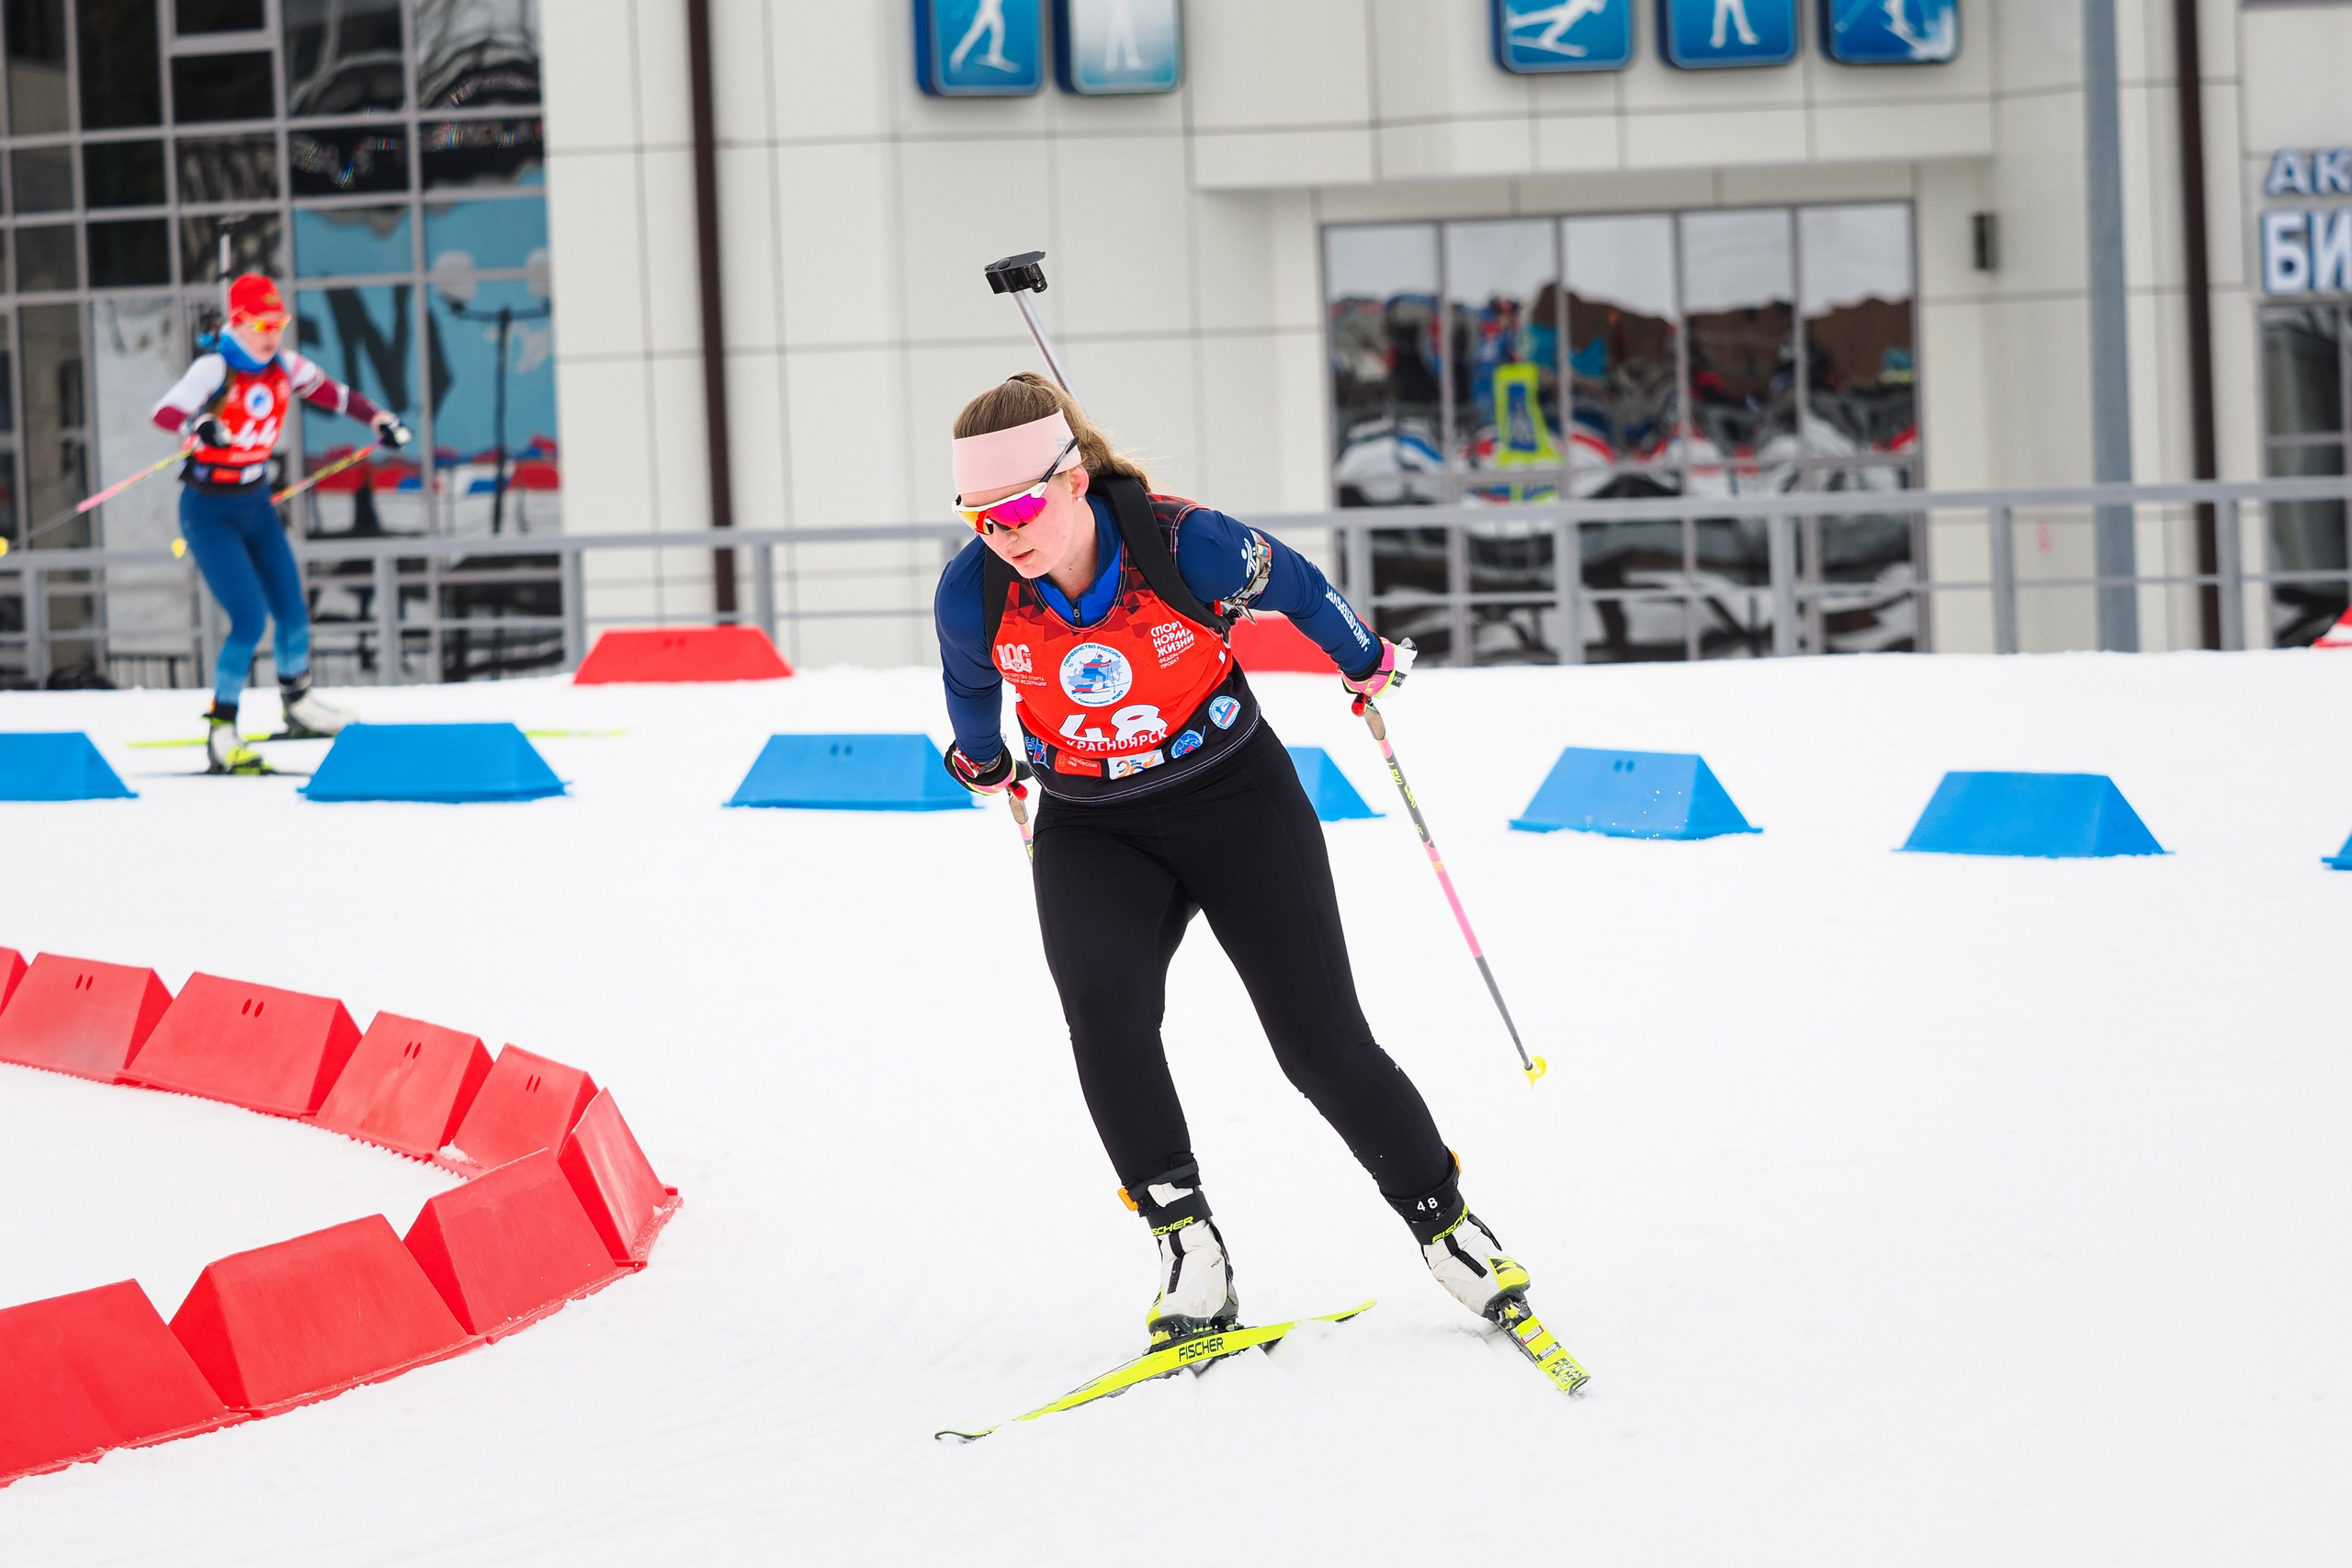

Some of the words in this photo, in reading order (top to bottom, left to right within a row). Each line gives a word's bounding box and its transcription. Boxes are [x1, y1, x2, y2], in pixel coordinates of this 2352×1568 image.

[2258, 209, 2352, 294] БИ
[1325, 586, 1370, 652] АНКТ-ПЕТЕРБУРГ
[1063, 644, 1096, 667] ПЕРВЕНСТВО
[1097, 645, 1122, 659] РОССИИ
[1156, 633, 1194, 659] ЖИЗНИ
[1058, 704, 1170, 742] 48
[1150, 1215, 1194, 1235] SCHER
[1179, 1337, 1225, 1363] FISCHER
